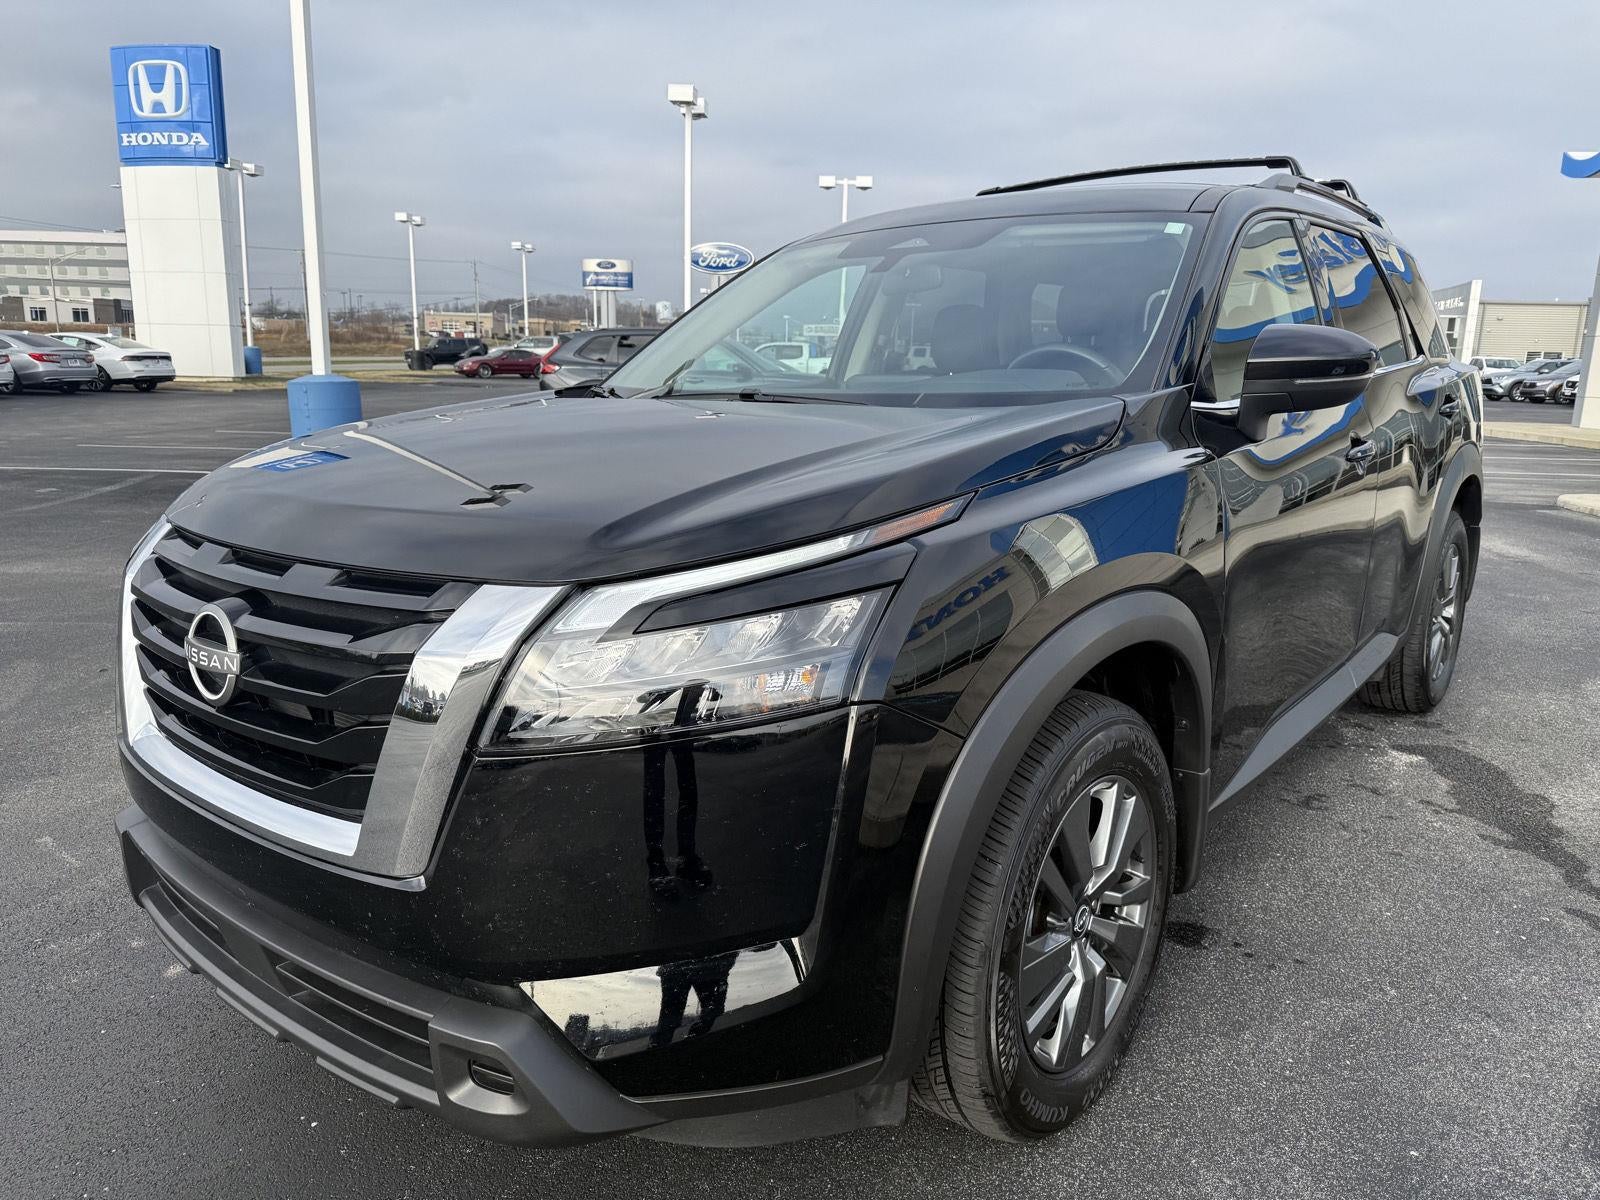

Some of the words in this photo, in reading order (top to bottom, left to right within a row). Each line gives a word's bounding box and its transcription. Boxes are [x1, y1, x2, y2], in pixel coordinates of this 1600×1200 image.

[121, 132, 210, 146] HONDA
[698, 247, 739, 267] Ford
[1020, 1087, 1069, 1123] KUMHO
